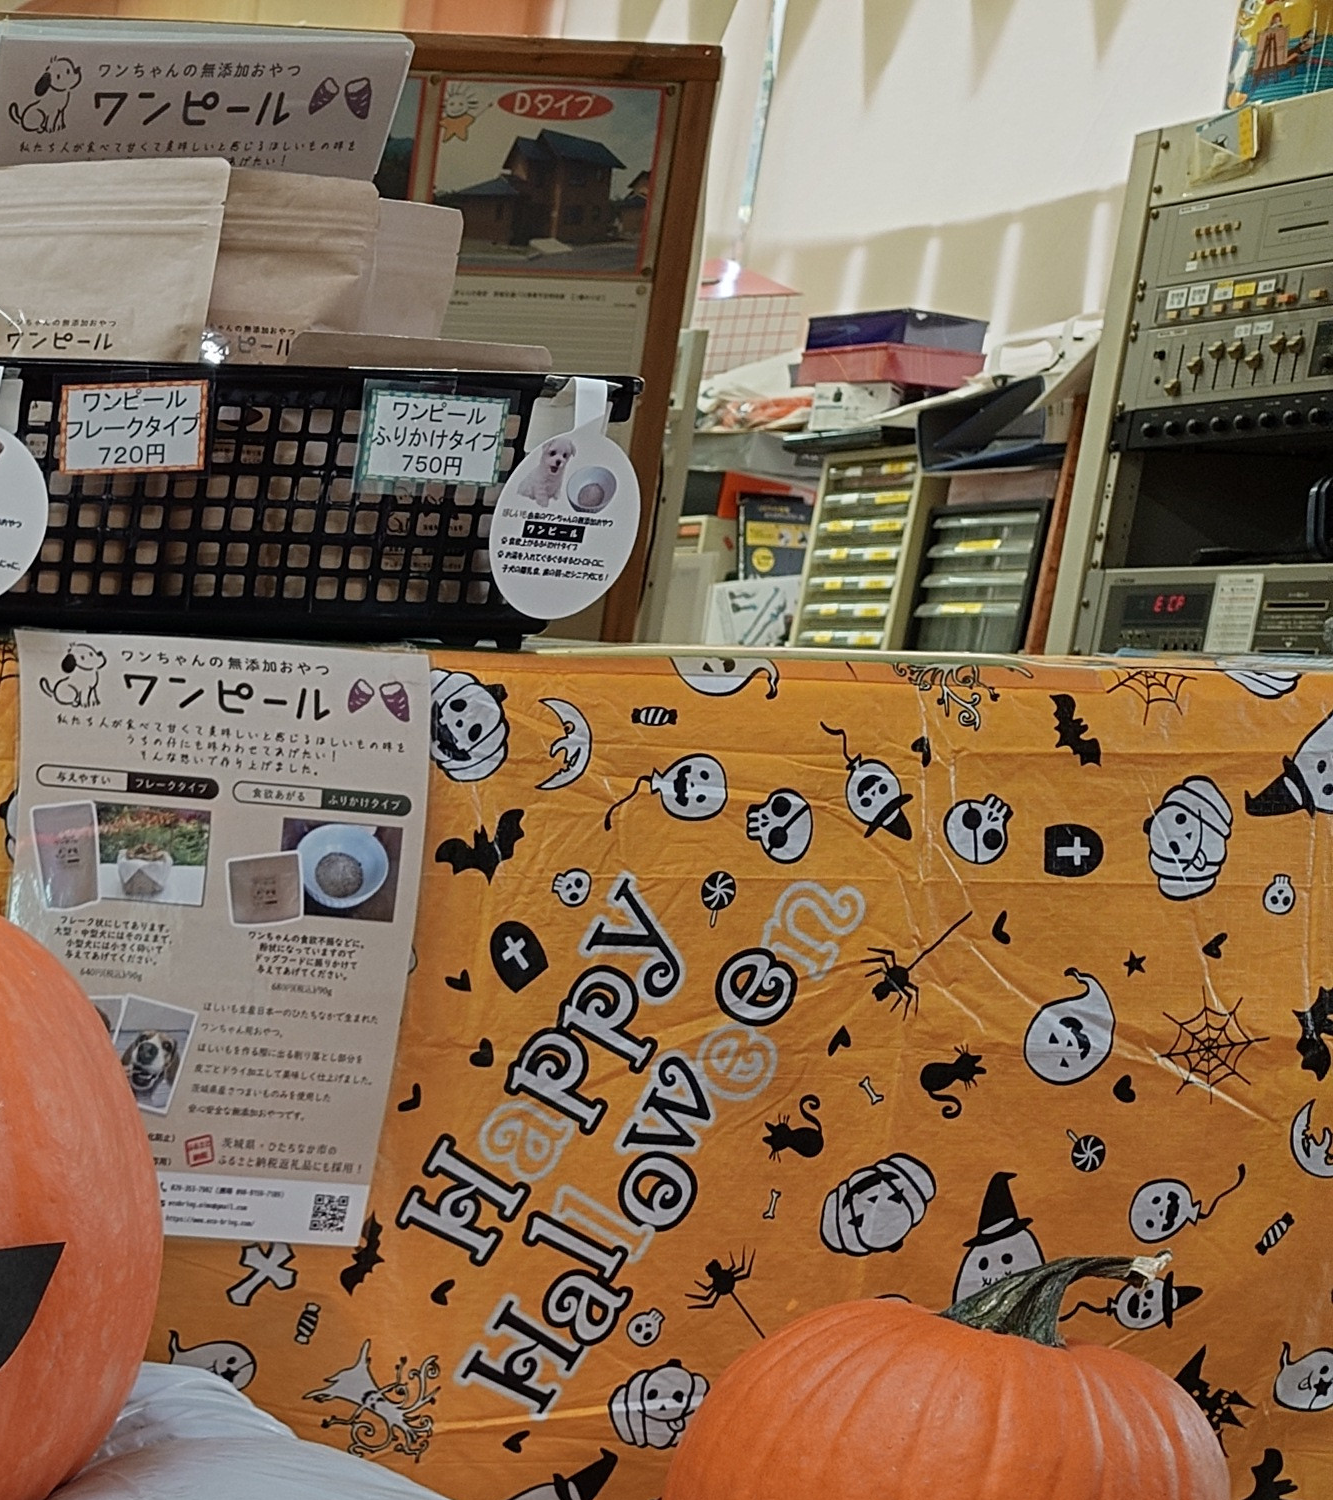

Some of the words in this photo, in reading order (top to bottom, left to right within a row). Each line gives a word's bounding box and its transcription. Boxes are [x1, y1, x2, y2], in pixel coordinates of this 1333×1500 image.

[98, 62, 302, 79] ワンちゃんの無添加おやつ
[93, 90, 291, 127] ワンピール
[512, 88, 596, 118] Dタイプ
[6, 332, 113, 351] ワンピール
[83, 388, 188, 413] ワンピール
[393, 402, 487, 425] ワンピール
[66, 412, 201, 440] フレークタイプ
[371, 425, 501, 452] ふりかけタイプ
[98, 443, 166, 465] 720円
[402, 454, 463, 477] 750円
[119, 648, 331, 677] ワンちゃんの無添加おやつ
[122, 672, 331, 723] ワンピール
[55, 771, 112, 786] 与えやすい
[134, 777, 208, 795] フレークタイプ
[251, 786, 307, 803] 食欲あがる
[327, 793, 402, 813] ふりかけタイプ
[397, 870, 686, 1267] Happy
[453, 880, 866, 1420] Halloween
